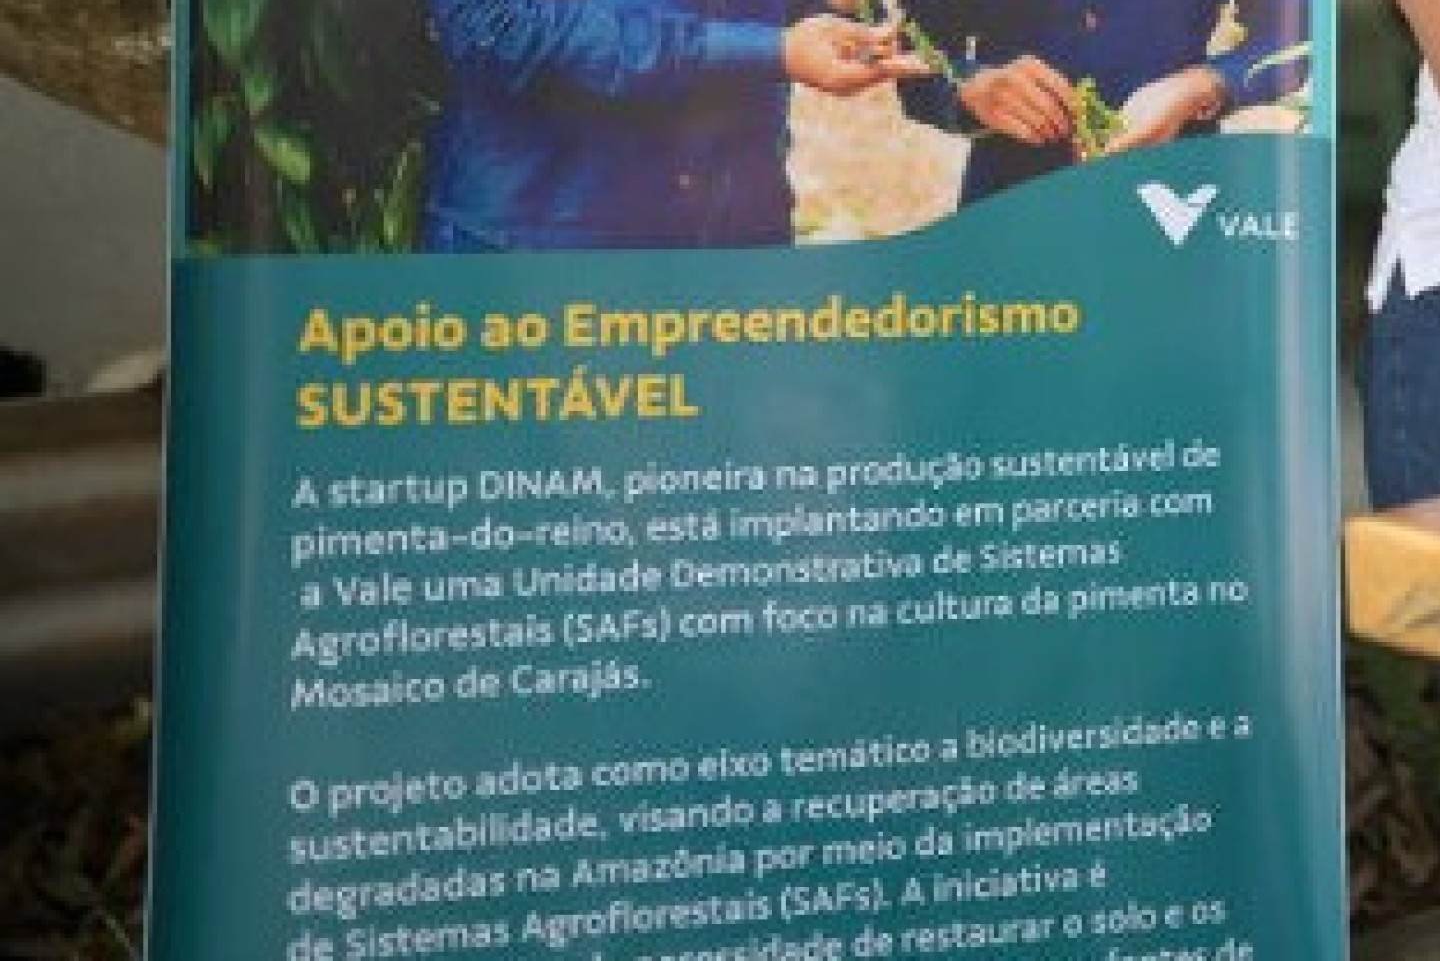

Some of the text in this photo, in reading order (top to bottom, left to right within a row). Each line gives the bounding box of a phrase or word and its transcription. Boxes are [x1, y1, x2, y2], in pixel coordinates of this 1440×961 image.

[1215, 210, 1300, 241] VALE
[299, 292, 1080, 364] Apoio ao Empreendedorismo
[297, 365, 699, 427] SUSTENTÁVEL
[291, 478, 319, 508] A
[328, 476, 467, 510] startup
[624, 462, 767, 503] pioneira
[776, 466, 821, 488] na
[827, 453, 982, 494] produção
[990, 440, 1174, 476] sustentável
[1180, 439, 1220, 467] de
[647, 513, 721, 540] está
[730, 498, 945, 544] implantando
[954, 503, 1003, 526] em
[1012, 490, 1138, 530] parceria
[1148, 494, 1212, 517] com
[300, 530, 1123, 609] a Vale uma Unidade Demonstrativa de Sistemas
[291, 579, 1248, 665] Agroflorestais (SAFs) com foco na cultura da pimenta no
[291, 679, 444, 711] Mosaico
[455, 666, 500, 698] de
[289, 712, 1253, 815] O projeto adota como eixo temático a biodiversidade e a
[619, 795, 754, 832] visando
[763, 799, 782, 822] a
[790, 776, 996, 822] recuperação
[1004, 772, 1045, 799] de
[1054, 767, 1137, 795] áreas
[288, 804, 1212, 919] degradadas na Amazônia por meio da implementação
[287, 933, 334, 961] de
[347, 919, 509, 957] Sistemas
[522, 895, 772, 947] Agroflorestais
[901, 878, 926, 904] A
[934, 864, 1078, 901] iniciativa
[1089, 860, 1106, 887] é
[851, 928, 893, 957] de
[901, 919, 1054, 952] restaurar
[1063, 915, 1082, 938] o
[1091, 901, 1156, 933] solo
[1164, 905, 1184, 928] e
[1192, 901, 1226, 924] os
